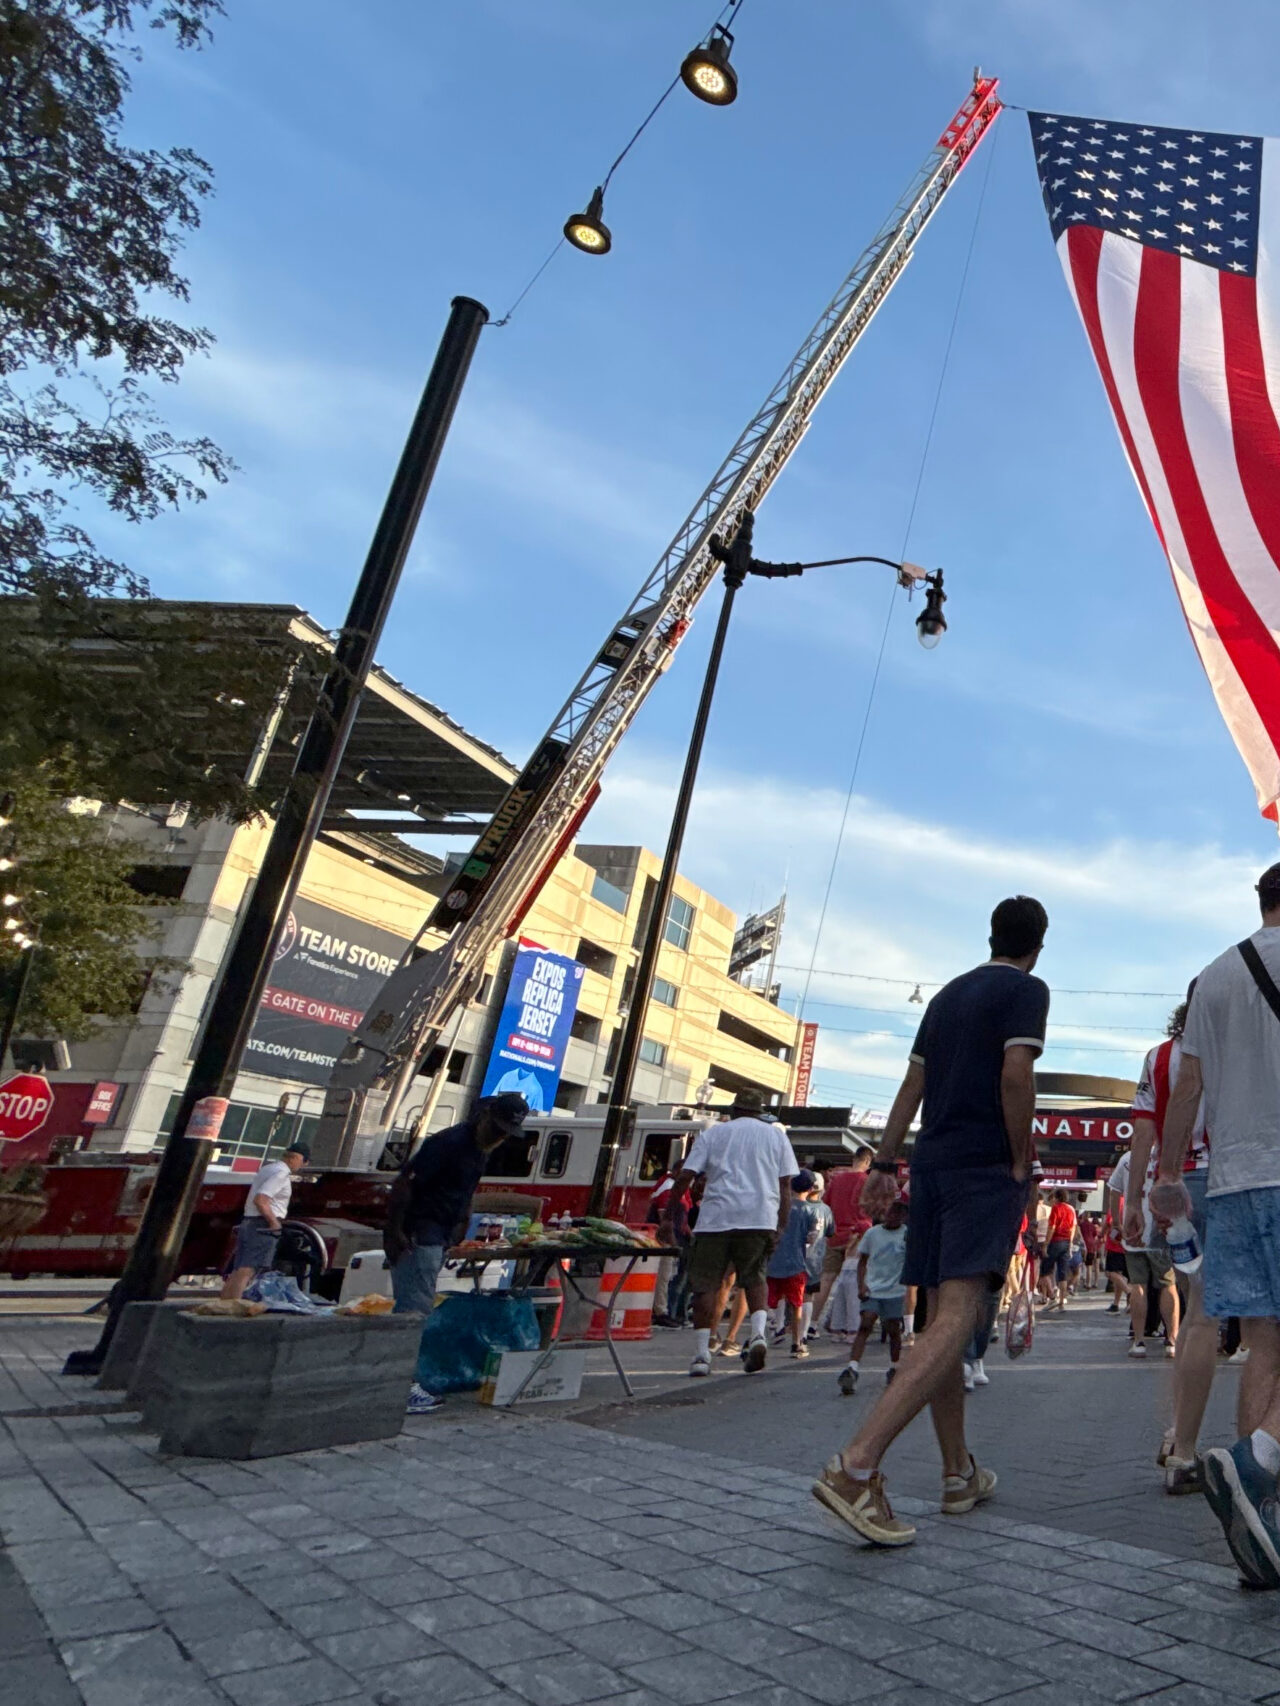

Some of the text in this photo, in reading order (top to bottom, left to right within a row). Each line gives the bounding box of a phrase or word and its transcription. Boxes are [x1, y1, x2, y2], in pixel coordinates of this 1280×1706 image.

[474, 786, 536, 857] TRUCK
[299, 926, 400, 977] TEAM STORE
[532, 957, 566, 990] EXPOS
[272, 993, 306, 1013] GATE
[307, 1003, 326, 1019] ON
[329, 1008, 351, 1025] THE
[522, 979, 564, 1015] REPLICA
[518, 1005, 557, 1037] JERSEY
[246, 1038, 337, 1068] ATS.COM/TEAMSTO
[795, 1040, 813, 1107] TEAM STORE
[1031, 1117, 1134, 1139] NATIO
